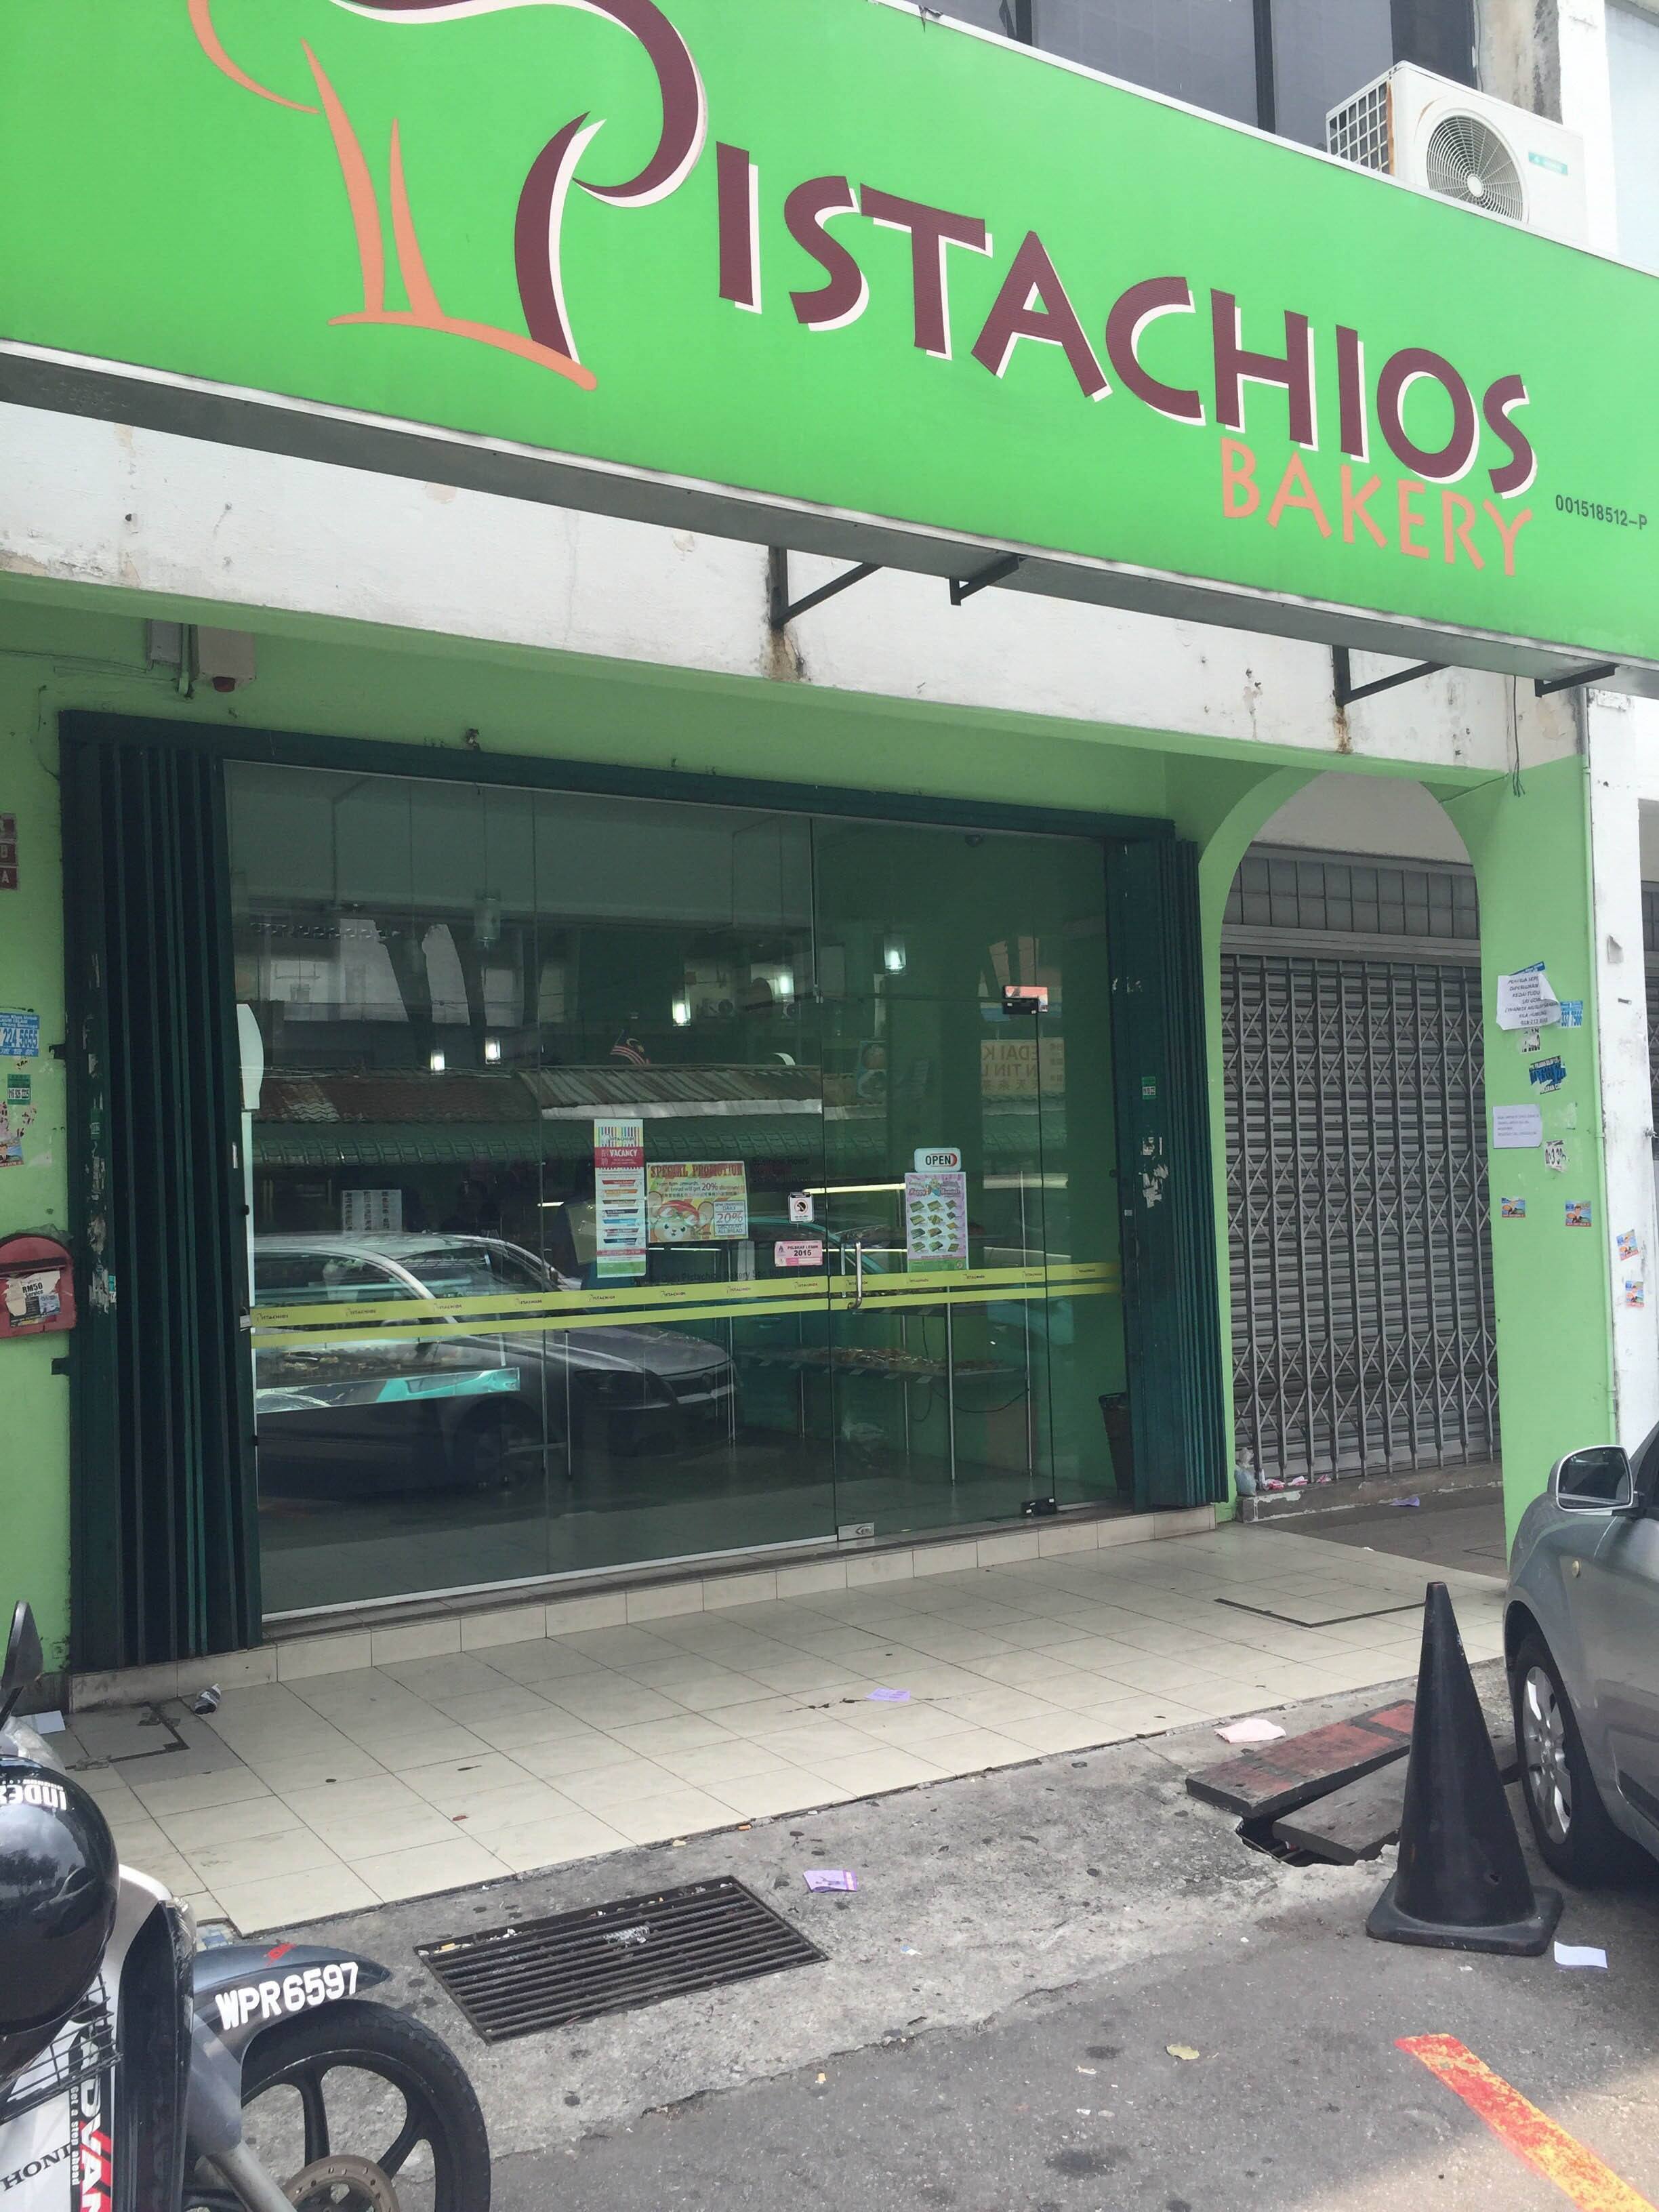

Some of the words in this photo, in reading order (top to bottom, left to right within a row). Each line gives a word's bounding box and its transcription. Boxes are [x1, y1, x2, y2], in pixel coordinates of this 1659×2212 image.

[331, 0, 1538, 500] PISTACHIOS
[1219, 438, 1533, 577] BAKERY
[1555, 493, 1649, 531] 001518512-P
[610, 1149, 638, 1157] VACANCY
[925, 1155, 951, 1166] OPEN
[651, 1165, 689, 1178] SPECIAL
[692, 1164, 743, 1178] PROMOTION
[701, 1183, 716, 1191] 20%
[716, 1212, 743, 1223] 20%
[22, 1282, 43, 1294] RM50
[215, 1961, 359, 2030] WPR6597
[70, 2085, 79, 2105] Get
[70, 2121, 79, 2146] step
[1, 2142, 72, 2191] HON
[71, 2150, 81, 2186] ahead
